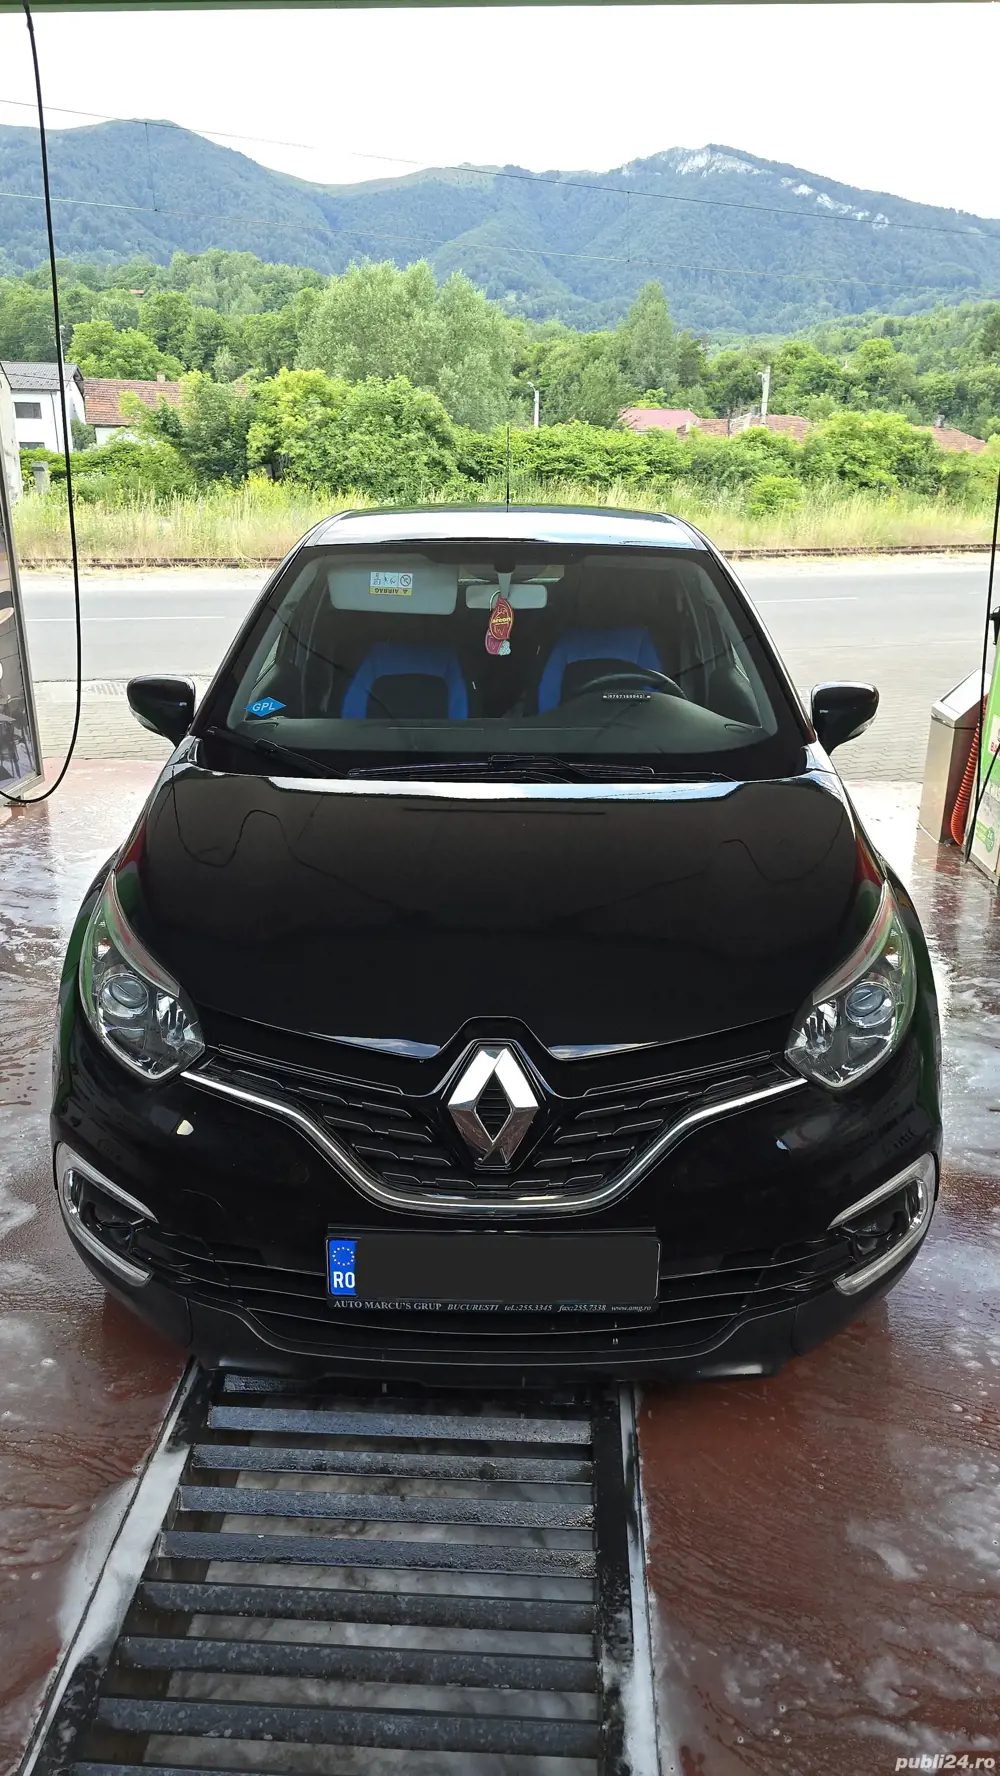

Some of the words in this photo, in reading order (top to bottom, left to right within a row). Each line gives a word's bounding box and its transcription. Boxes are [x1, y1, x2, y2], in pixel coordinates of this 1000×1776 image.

[252, 702, 275, 711] GPL
[333, 1271, 356, 1288] RO
[334, 1300, 362, 1308] AUTO
[414, 1302, 442, 1310] GRUP
